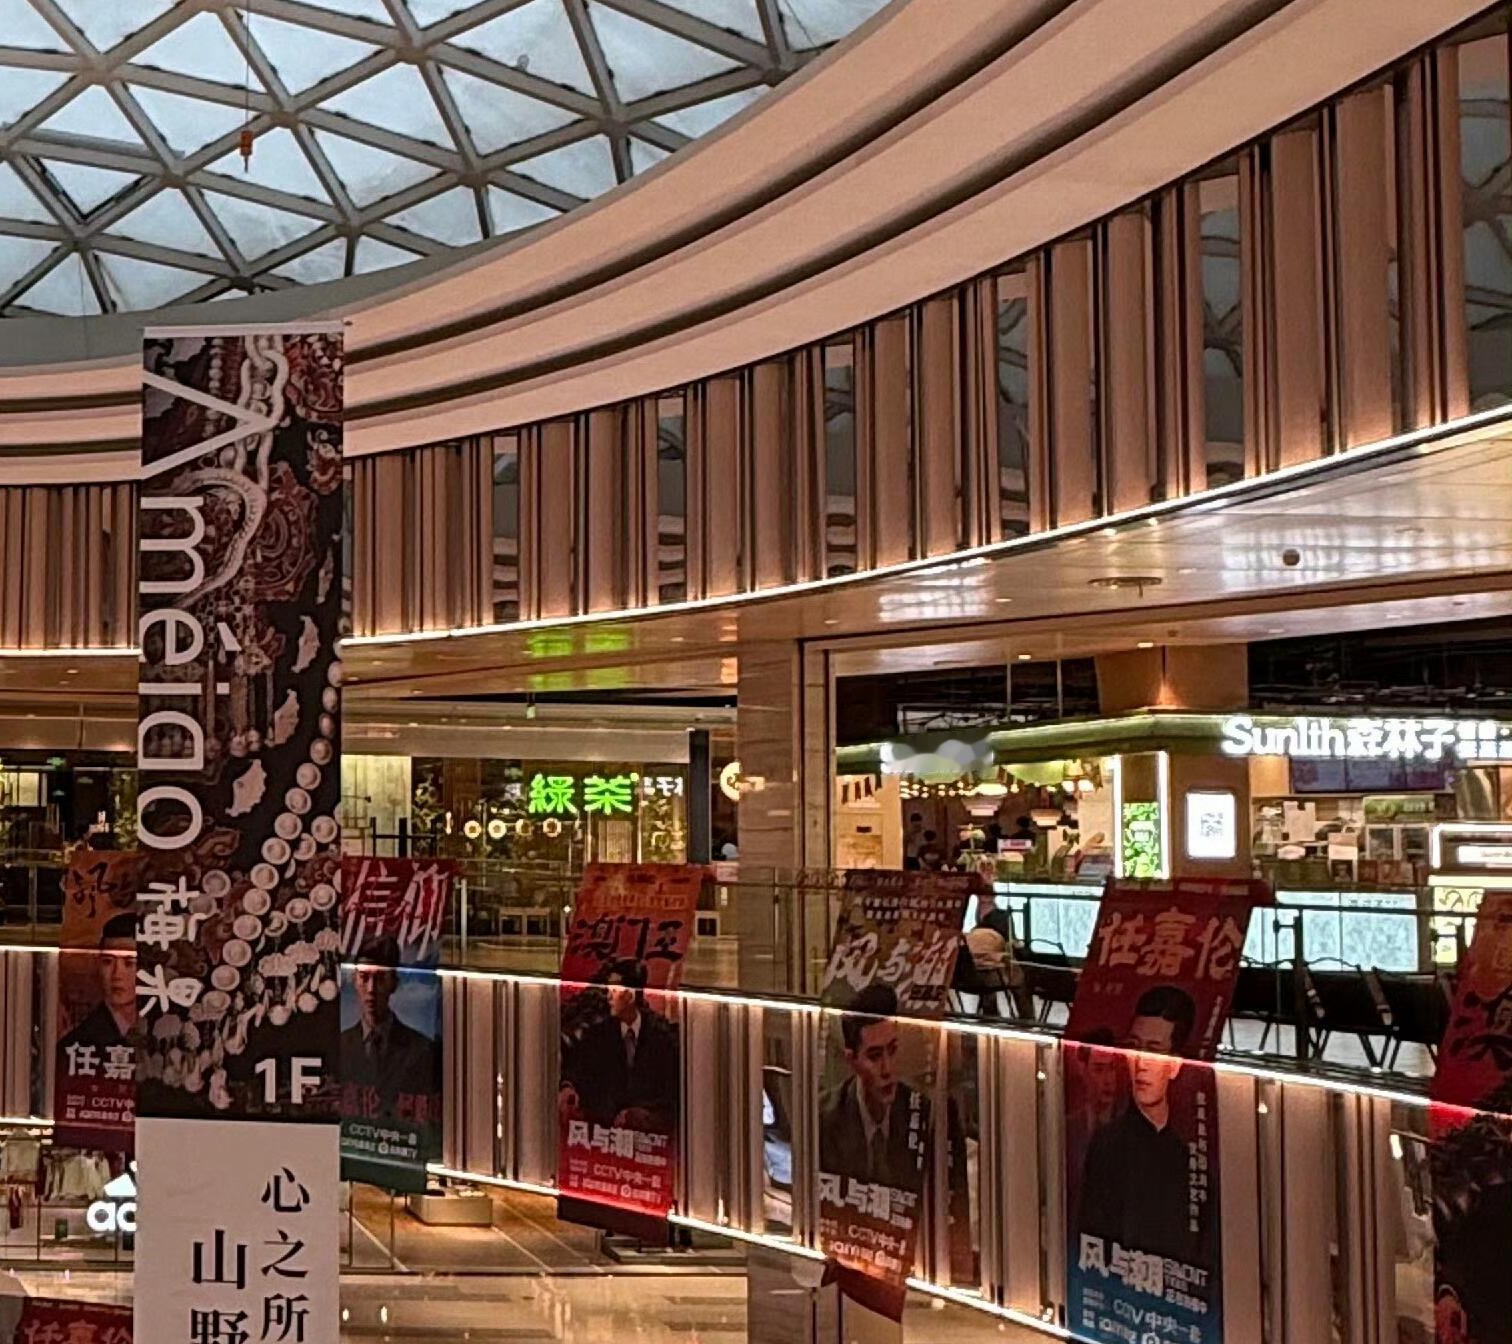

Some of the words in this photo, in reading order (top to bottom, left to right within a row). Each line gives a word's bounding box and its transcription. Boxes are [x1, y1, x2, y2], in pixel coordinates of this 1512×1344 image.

[1099, 906, 1242, 979] 任嘉伦
[66, 1042, 136, 1079] 任嘉
[254, 1056, 323, 1105] 1F
